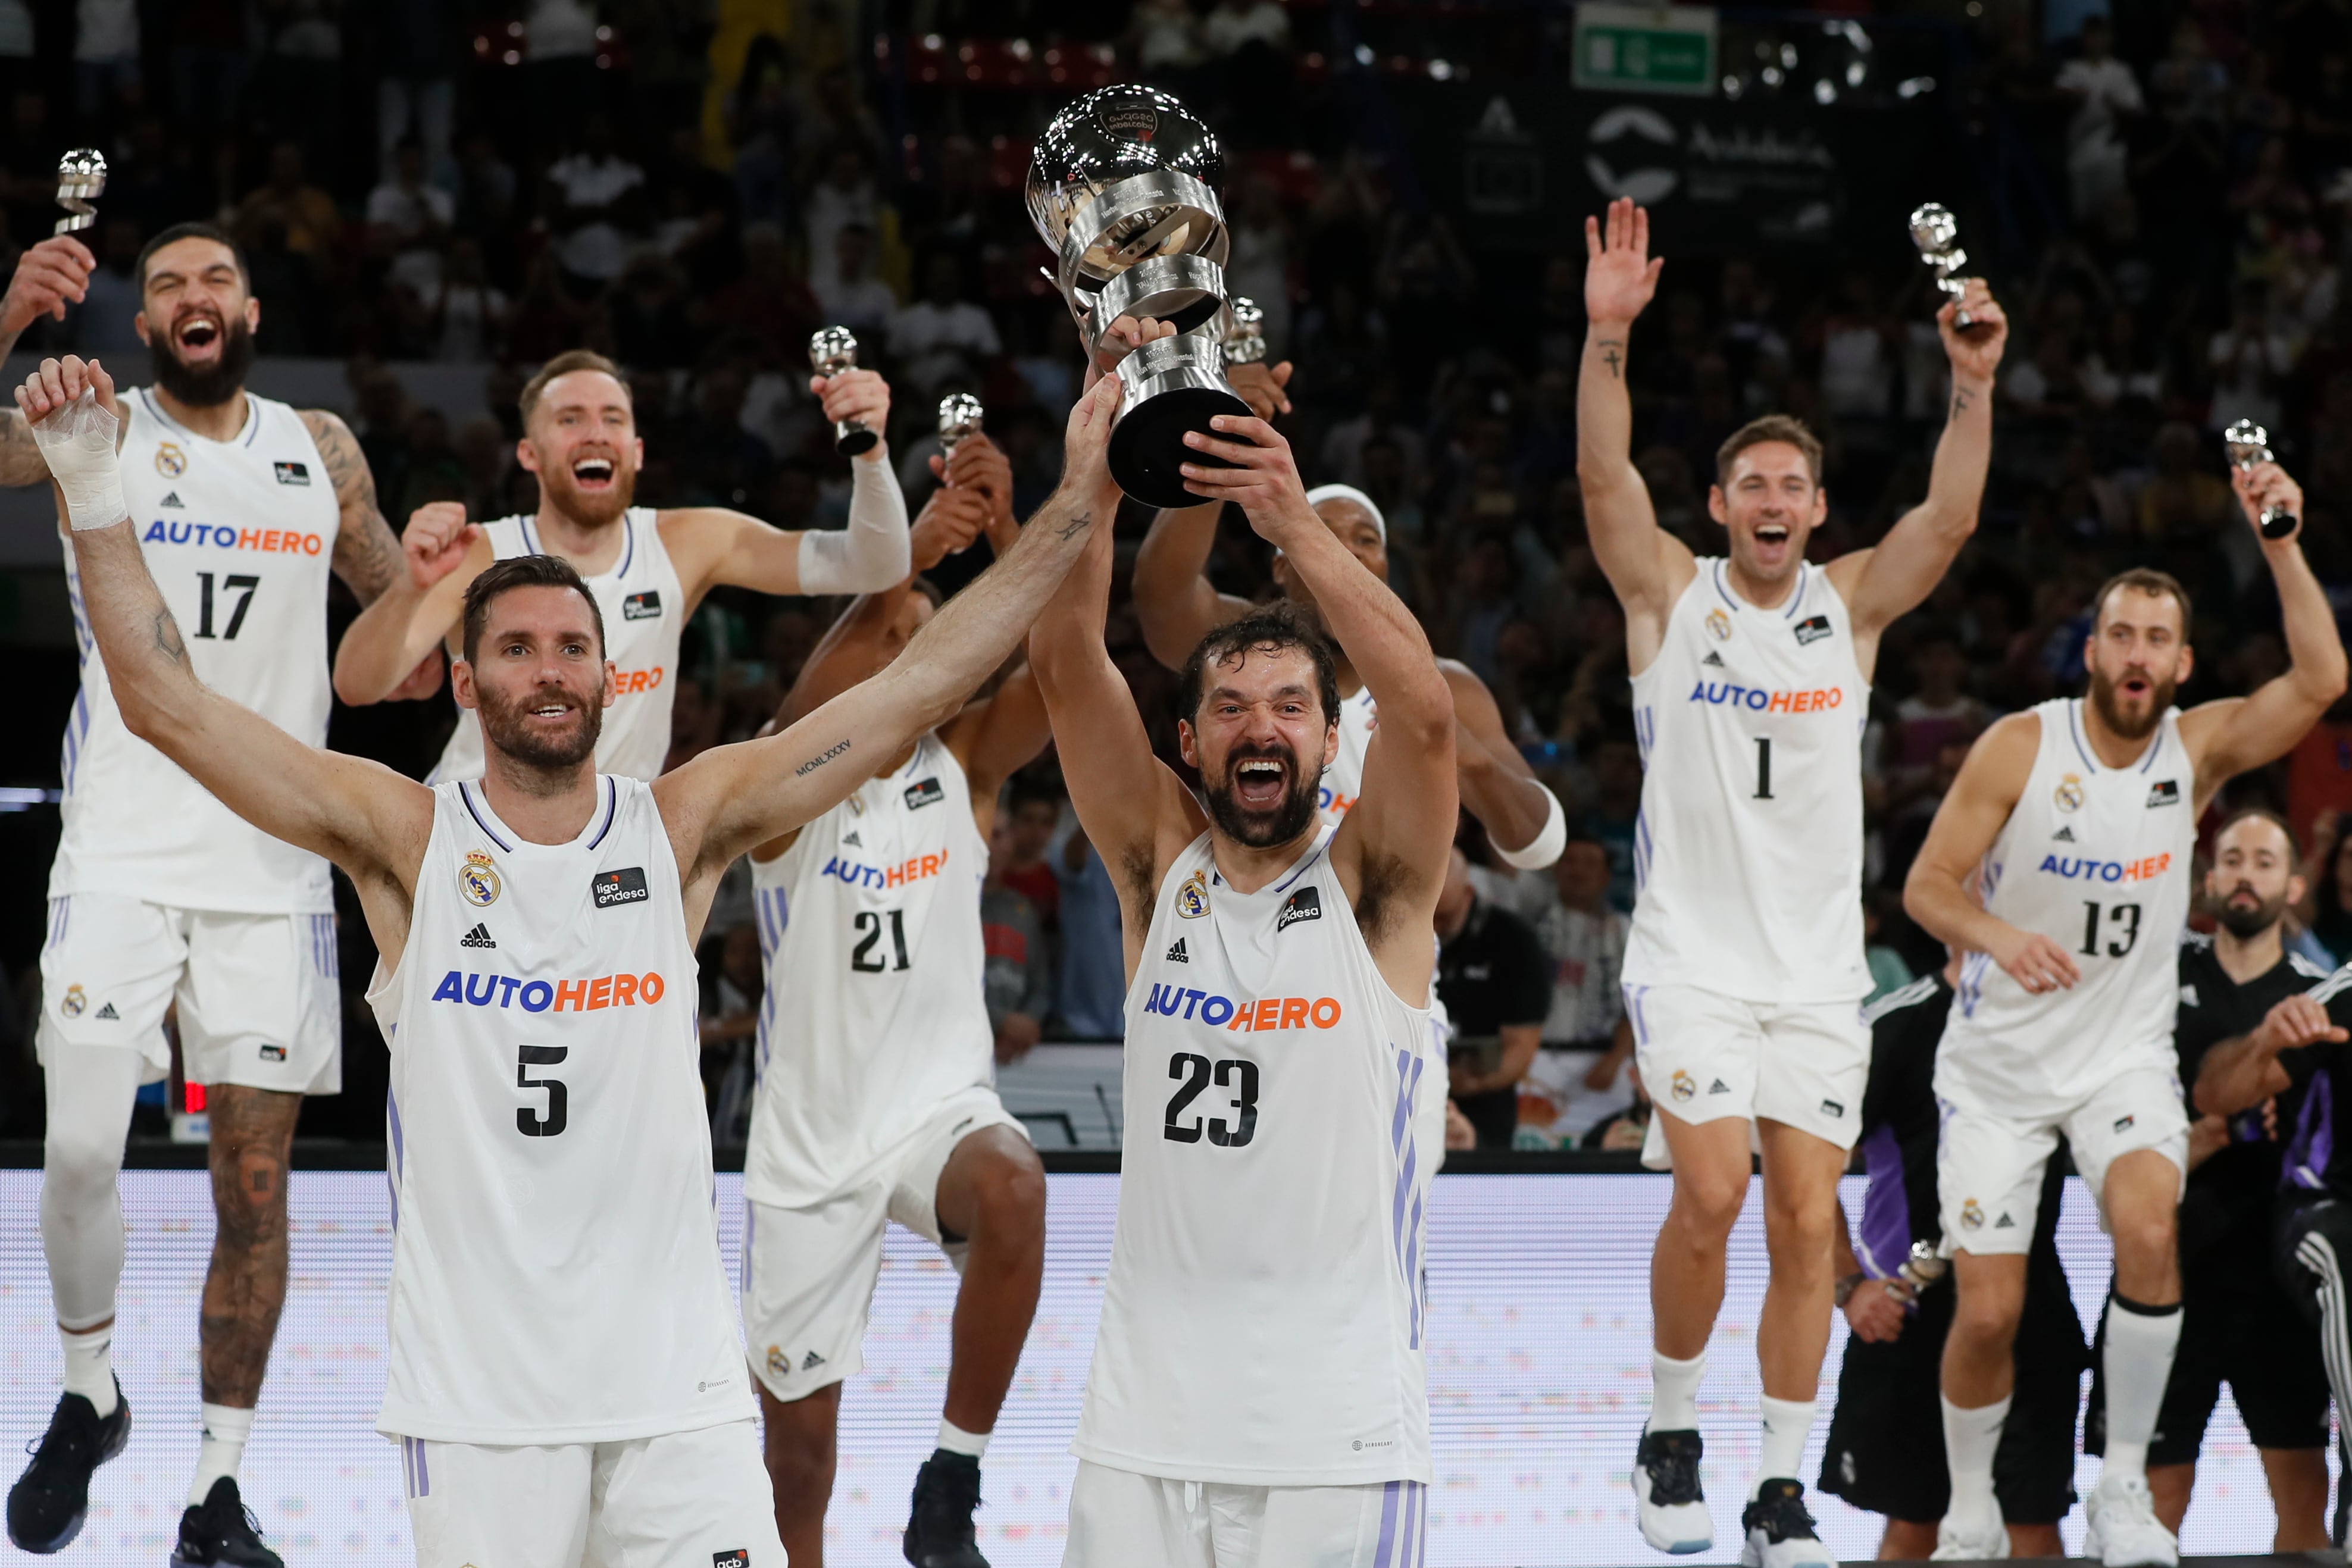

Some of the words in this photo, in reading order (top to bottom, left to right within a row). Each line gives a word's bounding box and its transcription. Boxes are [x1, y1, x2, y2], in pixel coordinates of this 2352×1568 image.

[145, 521, 321, 556] AUTOHERO
[195, 573, 259, 640] 17
[616, 667, 663, 694] ERO
[1691, 683, 1841, 713] AUTOHERO
[796, 739, 850, 777] MCMLXXXV
[1753, 737, 1775, 799] 1
[2040, 852, 2171, 882] AUTOHER
[596, 883, 618, 894] liga
[599, 888, 646, 903] endesa
[1280, 907, 1319, 927] endesa
[2078, 900, 2141, 959] 13
[460, 937, 496, 949] adidas
[852, 909, 909, 973] 21
[432, 971, 665, 1012] AUTOHERO
[1144, 983, 1341, 1032] AUTOHERO
[517, 1045, 568, 1137] 5
[1164, 1052, 1260, 1147] 23
